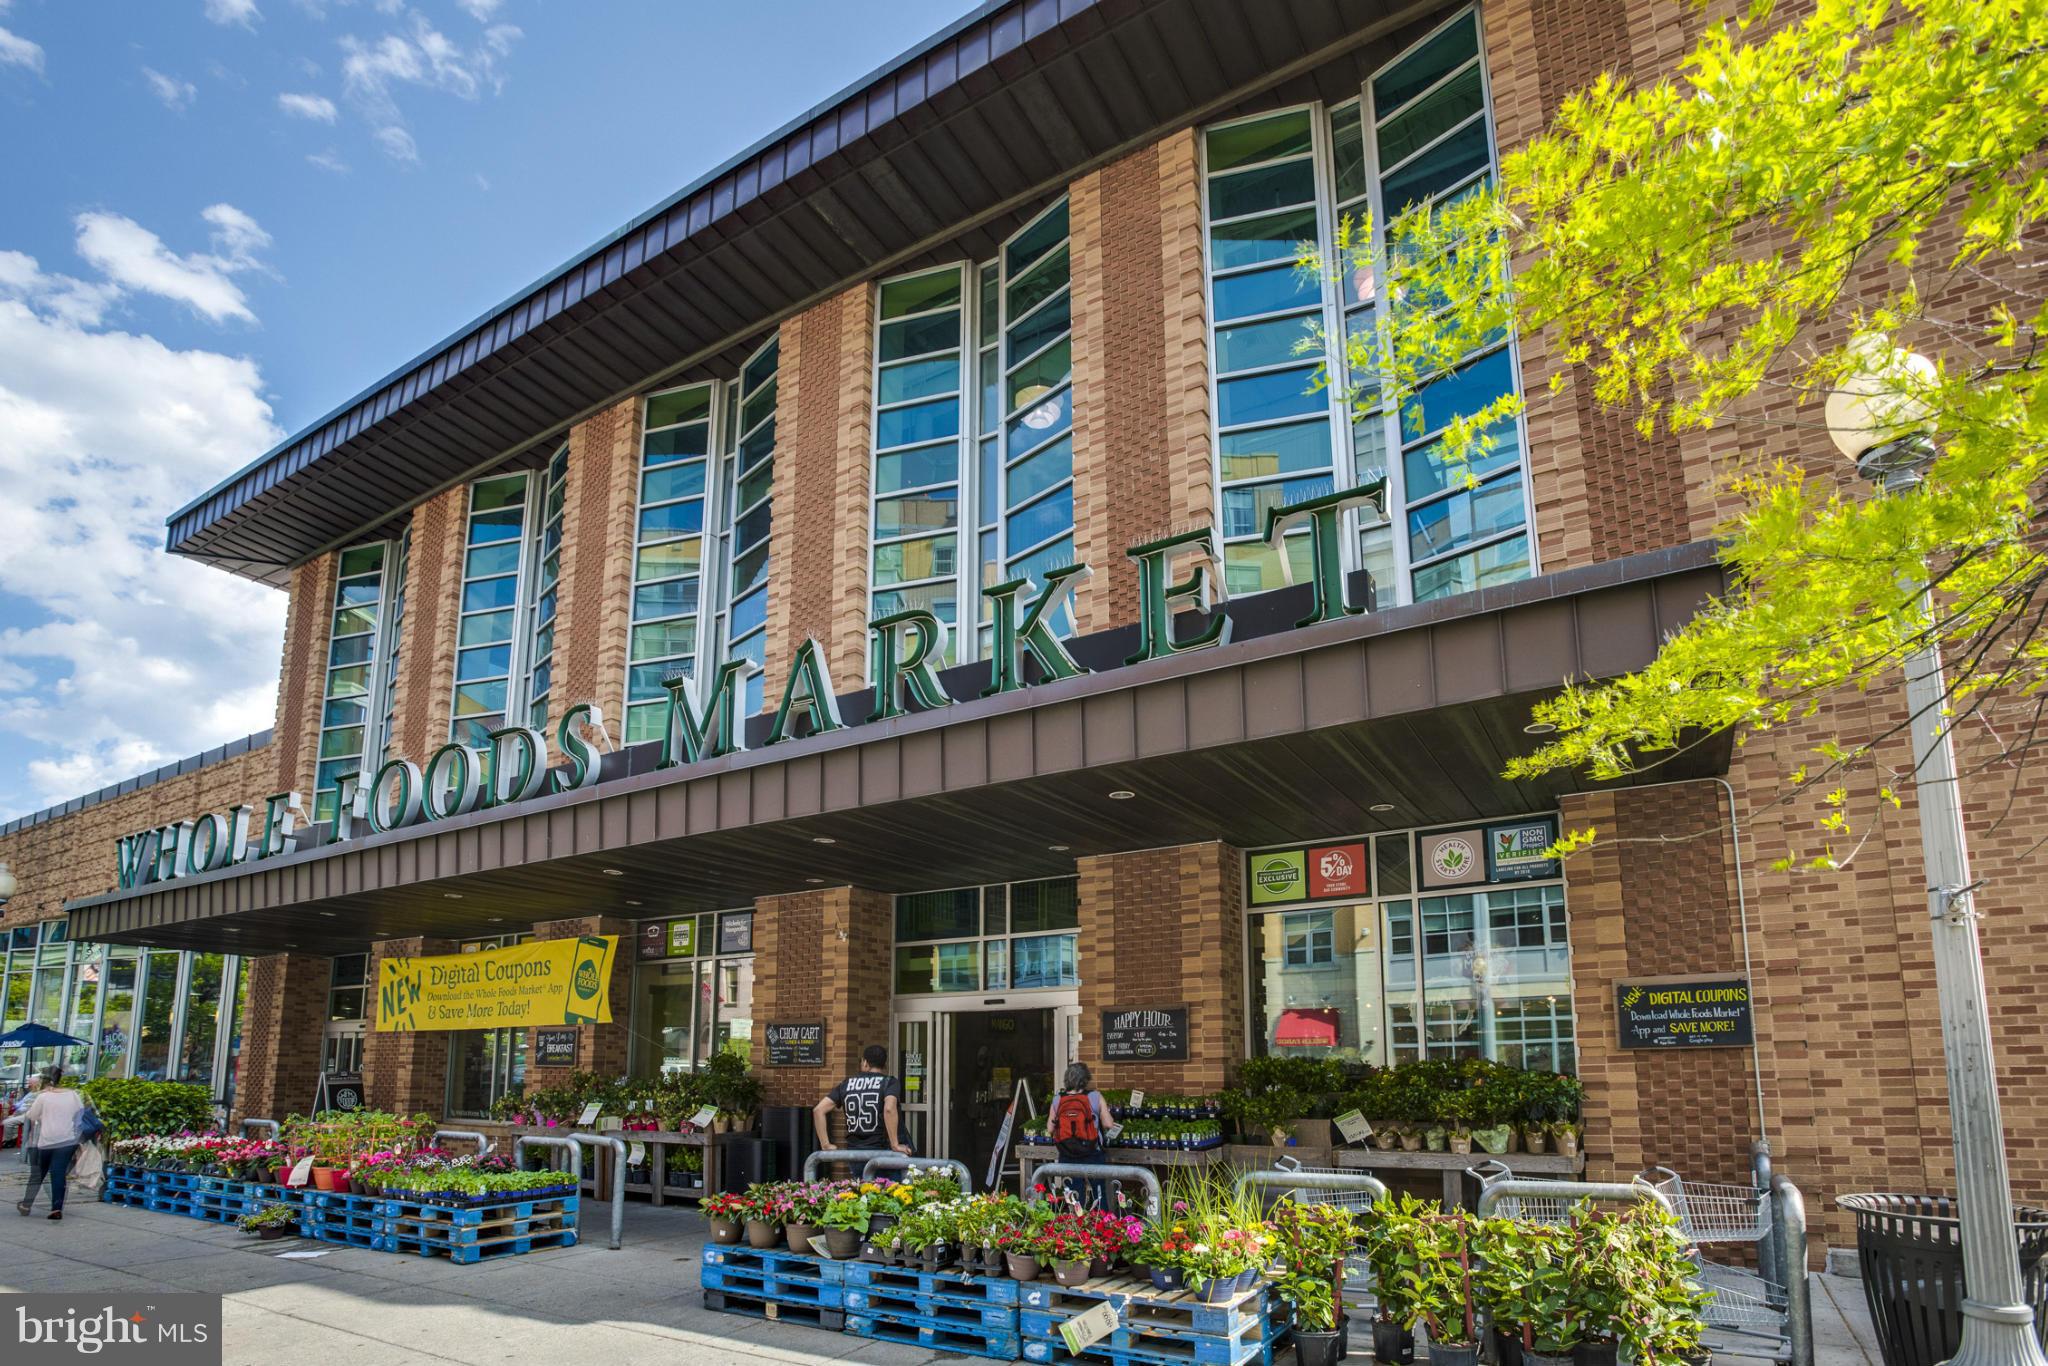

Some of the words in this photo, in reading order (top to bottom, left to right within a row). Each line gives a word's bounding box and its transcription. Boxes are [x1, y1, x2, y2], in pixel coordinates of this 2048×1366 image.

[116, 792, 301, 890] WHOLE
[327, 703, 602, 844] FOODS
[655, 476, 1392, 770] MARKET
[1522, 829, 1543, 837] NON
[1522, 835, 1544, 843] GMO
[1439, 842, 1466, 853] HEALTH
[1337, 865, 1353, 876] DAY
[1436, 859, 1456, 875] STARTS
[1458, 856, 1470, 873] HERE
[1259, 872, 1297, 883] EXCLUSIVE
[431, 962, 480, 989] Digital
[485, 959, 551, 983] Coupons
[382, 969, 421, 1023] NEW
[427, 989, 462, 1001] Download
[463, 989, 474, 999] the
[476, 986, 497, 999] Whole
[498, 985, 517, 996] Foods
[548, 982, 563, 995] App
[1622, 985, 1643, 1008] NEW
[1649, 990, 1694, 1005] DIGITAL
[1695, 988, 1747, 1003] COUPONS
[427, 1005, 437, 1020] &
[439, 1003, 464, 1019] Save
[466, 1002, 494, 1017] More
[497, 999, 531, 1019] Today!
[1631, 1010, 1668, 1021] Download
[1669, 1008, 1691, 1019] Whole
[1692, 1007, 1713, 1018] Foods
[1114, 1010, 1141, 1029] HAPPY
[1143, 1010, 1174, 1027] HOUR
[780, 1026, 800, 1040] CHOW
[800, 1026, 820, 1040] CART
[1631, 1024, 1650, 1040] App
[1653, 1025, 1666, 1034] and
[1670, 1021, 1698, 1034] SAVE
[1700, 1020, 1736, 1032] MORE!
[546, 1043, 574, 1054] BREAKFAST
[846, 1076, 884, 1091] HOME
[844, 1092, 880, 1132] 95
